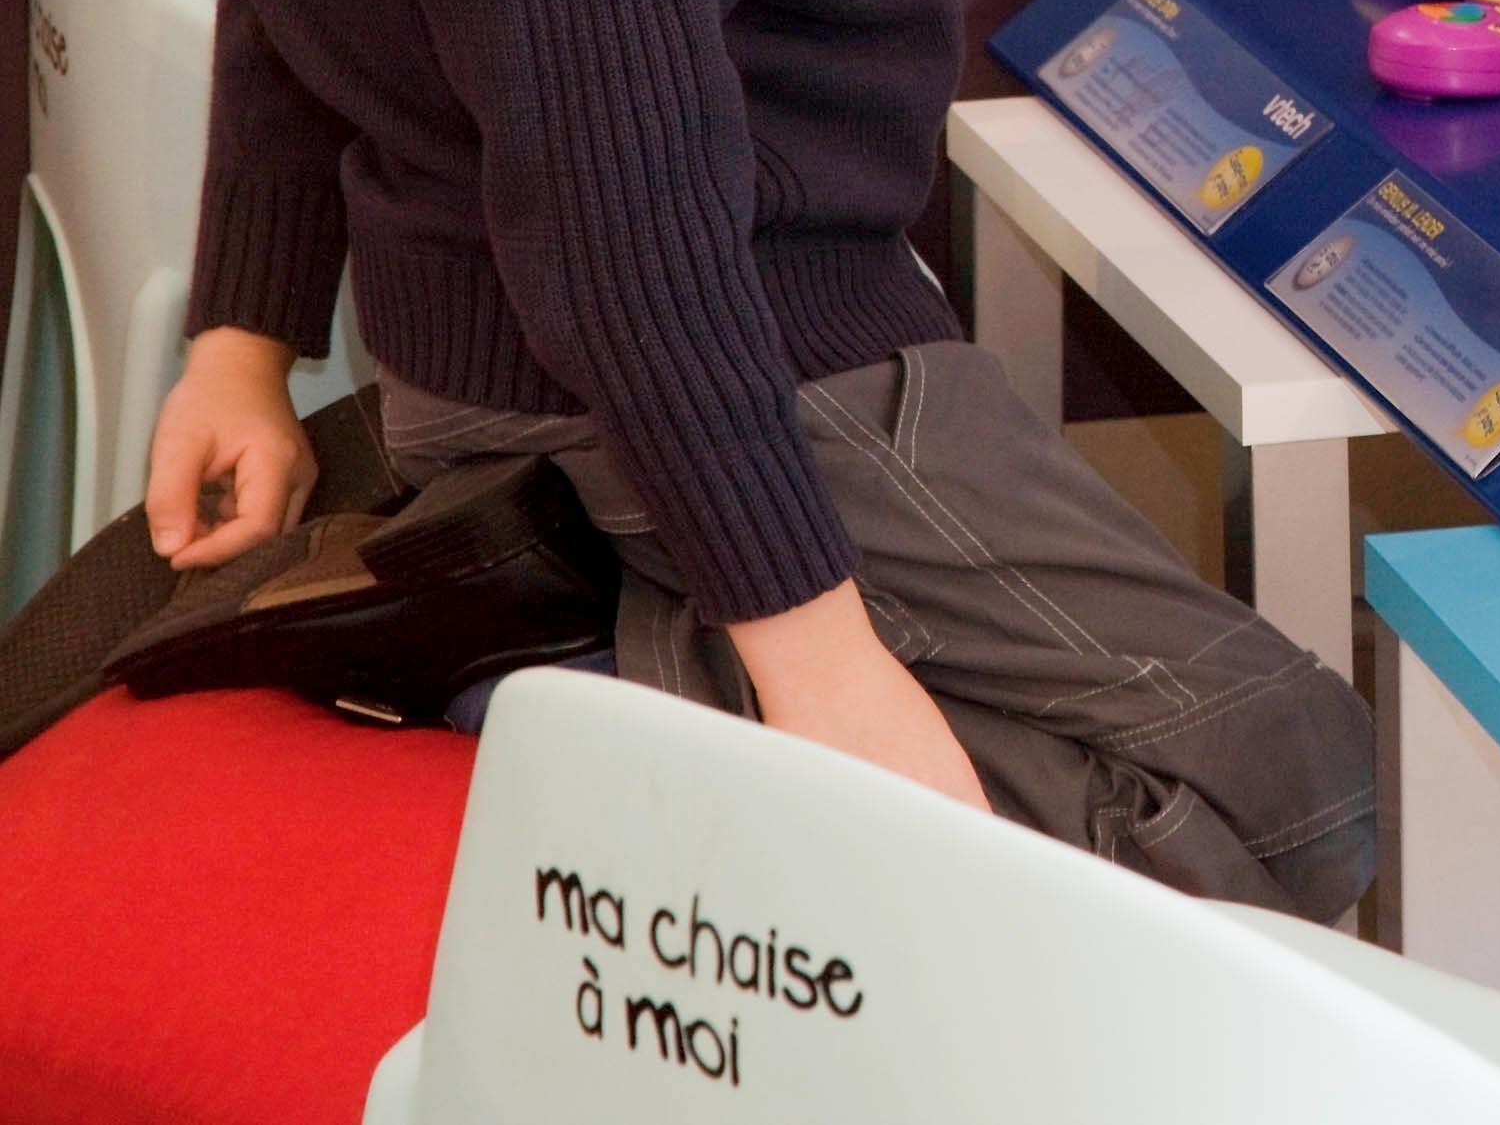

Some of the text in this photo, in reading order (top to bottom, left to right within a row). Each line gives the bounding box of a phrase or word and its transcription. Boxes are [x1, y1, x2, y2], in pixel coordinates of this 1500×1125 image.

[1261, 93, 1315, 140] vtech
[536, 866, 863, 1018] ma chaise
[575, 956, 740, 1087] à moi
